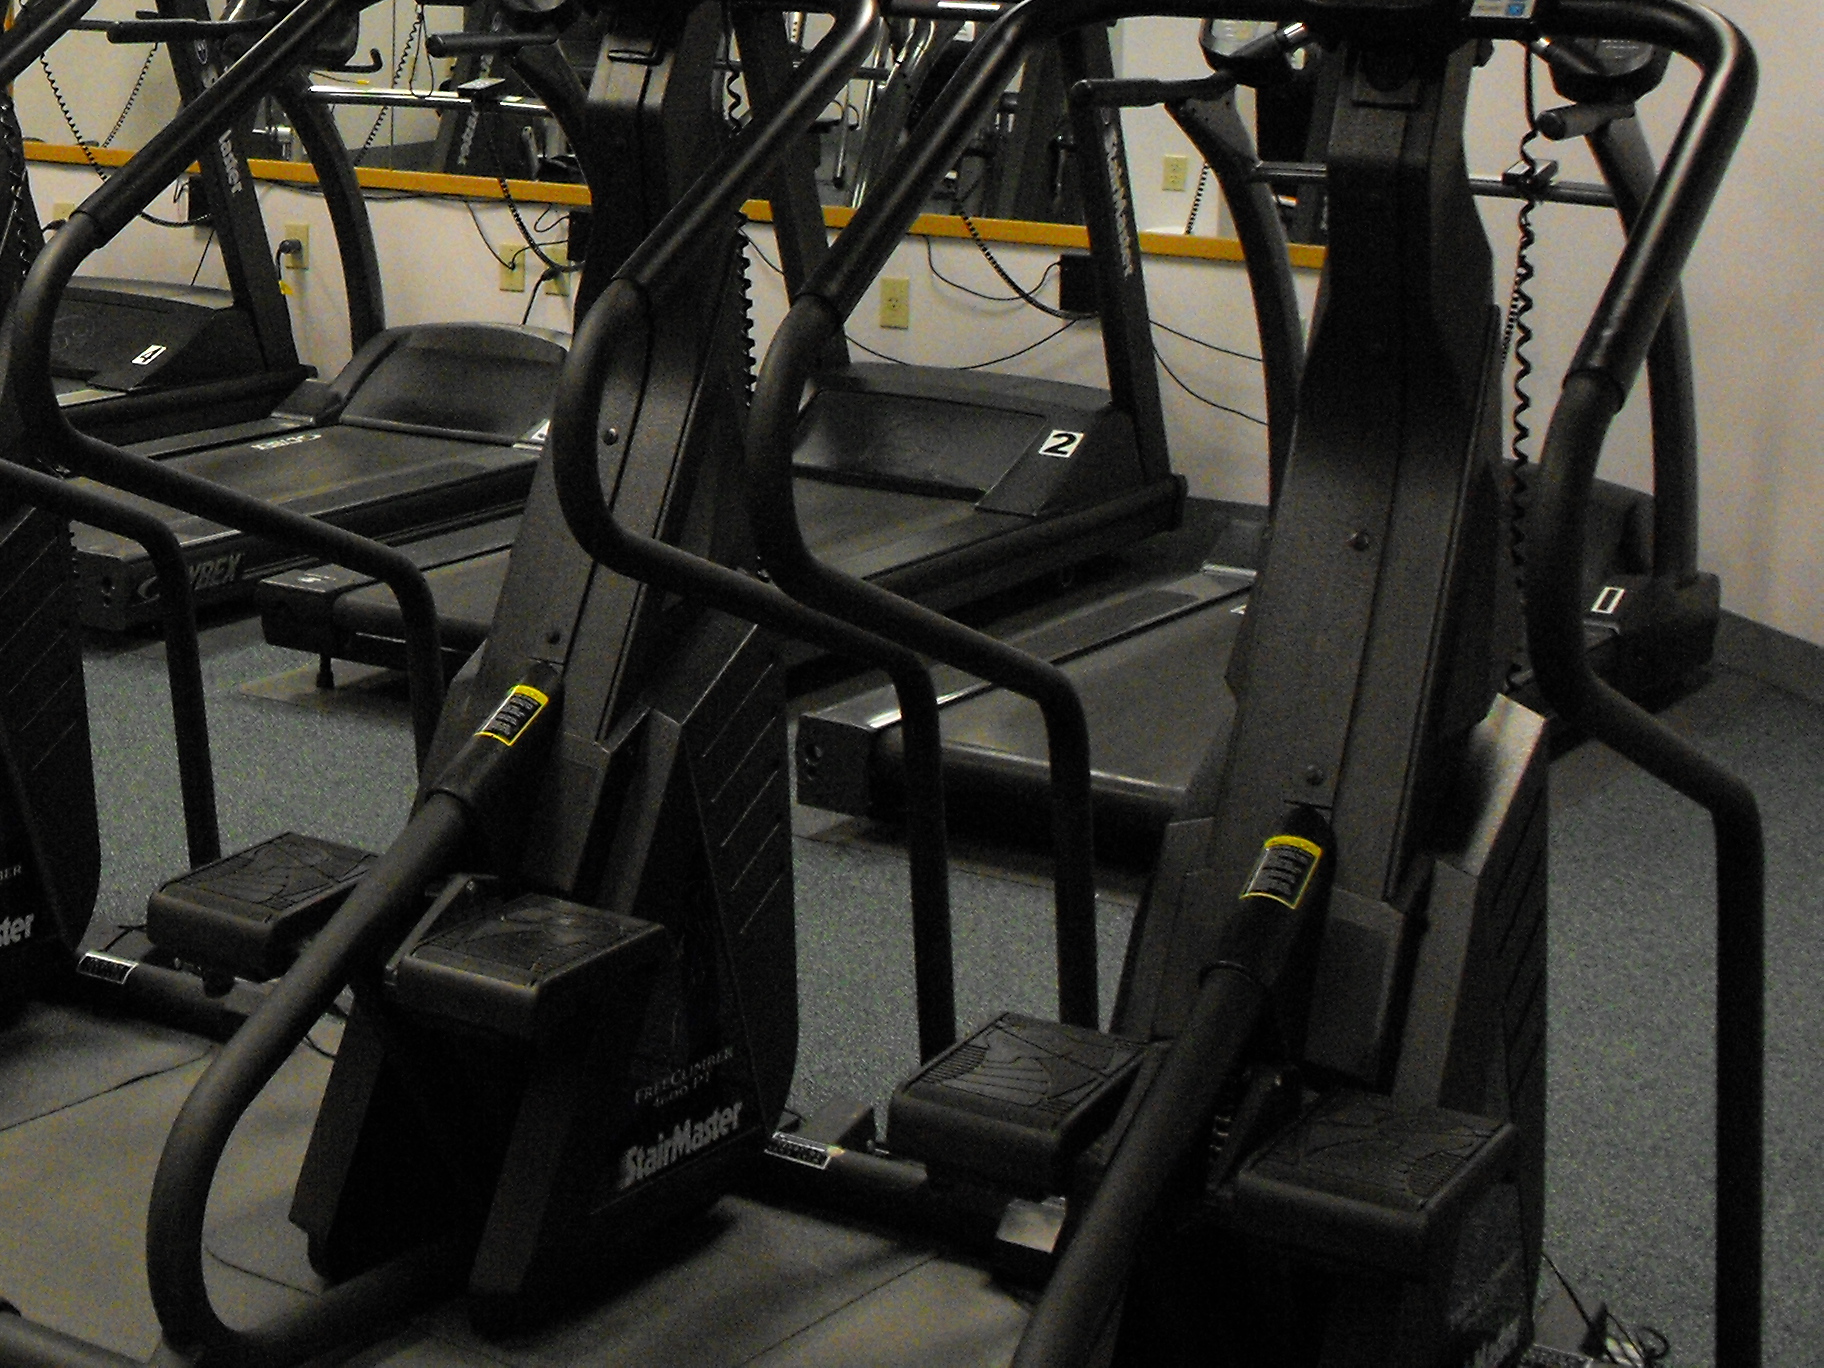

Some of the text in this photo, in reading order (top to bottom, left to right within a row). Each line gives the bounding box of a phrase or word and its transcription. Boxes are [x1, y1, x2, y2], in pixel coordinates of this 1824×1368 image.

[137, 346, 162, 365] 4
[1047, 433, 1078, 456] 2
[619, 1101, 743, 1190] StairMaster
